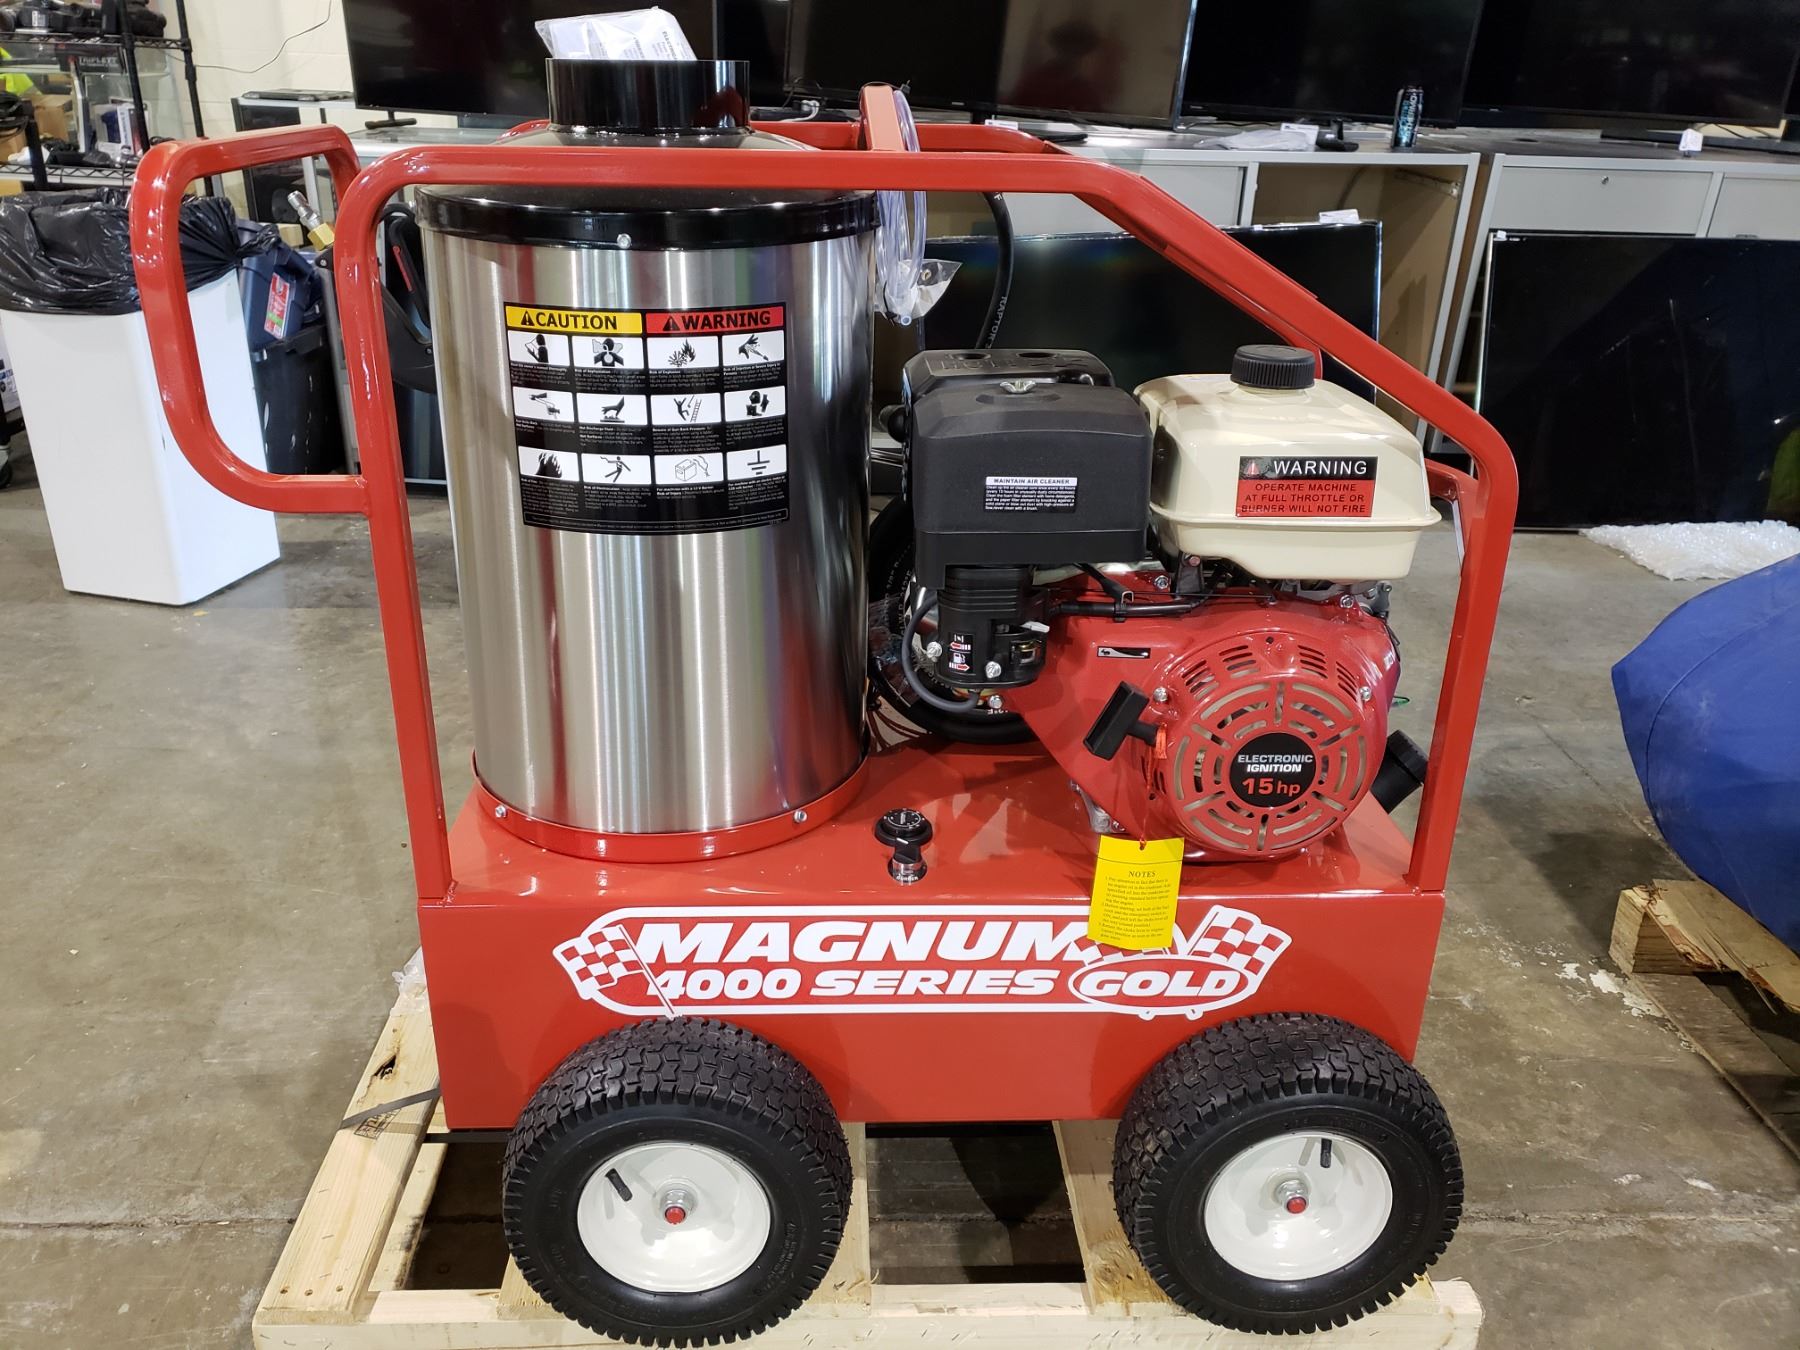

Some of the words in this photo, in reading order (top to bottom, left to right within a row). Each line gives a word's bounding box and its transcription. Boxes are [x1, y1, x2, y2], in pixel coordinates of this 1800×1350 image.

[538, 312, 617, 330] CAUTION
[682, 310, 771, 330] WARNING
[990, 296, 1008, 342] RAPTOR
[1273, 460, 1367, 475] WARNING
[1255, 483, 1305, 492] OPERATE
[1308, 484, 1357, 492] MACHINE
[1244, 494, 1260, 502] AT
[1261, 494, 1287, 502] FULL
[1291, 494, 1345, 502] THROTTLE
[1349, 494, 1365, 502] OR
[1241, 504, 1285, 512] BURNER
[1288, 504, 1313, 512] WILL
[1317, 504, 1339, 512] NOT
[1342, 504, 1366, 513] FIRE
[1237, 754, 1314, 764] ELECTRONIC
[1247, 764, 1302, 773] IGNITION
[1242, 778, 1274, 795] 15
[1276, 780, 1301, 797] hp
[635, 920, 1090, 964] MAGNUM
[646, 968, 802, 1000] 4000
[809, 969, 1061, 997] SERIES
[1079, 970, 1241, 997] GOLD
